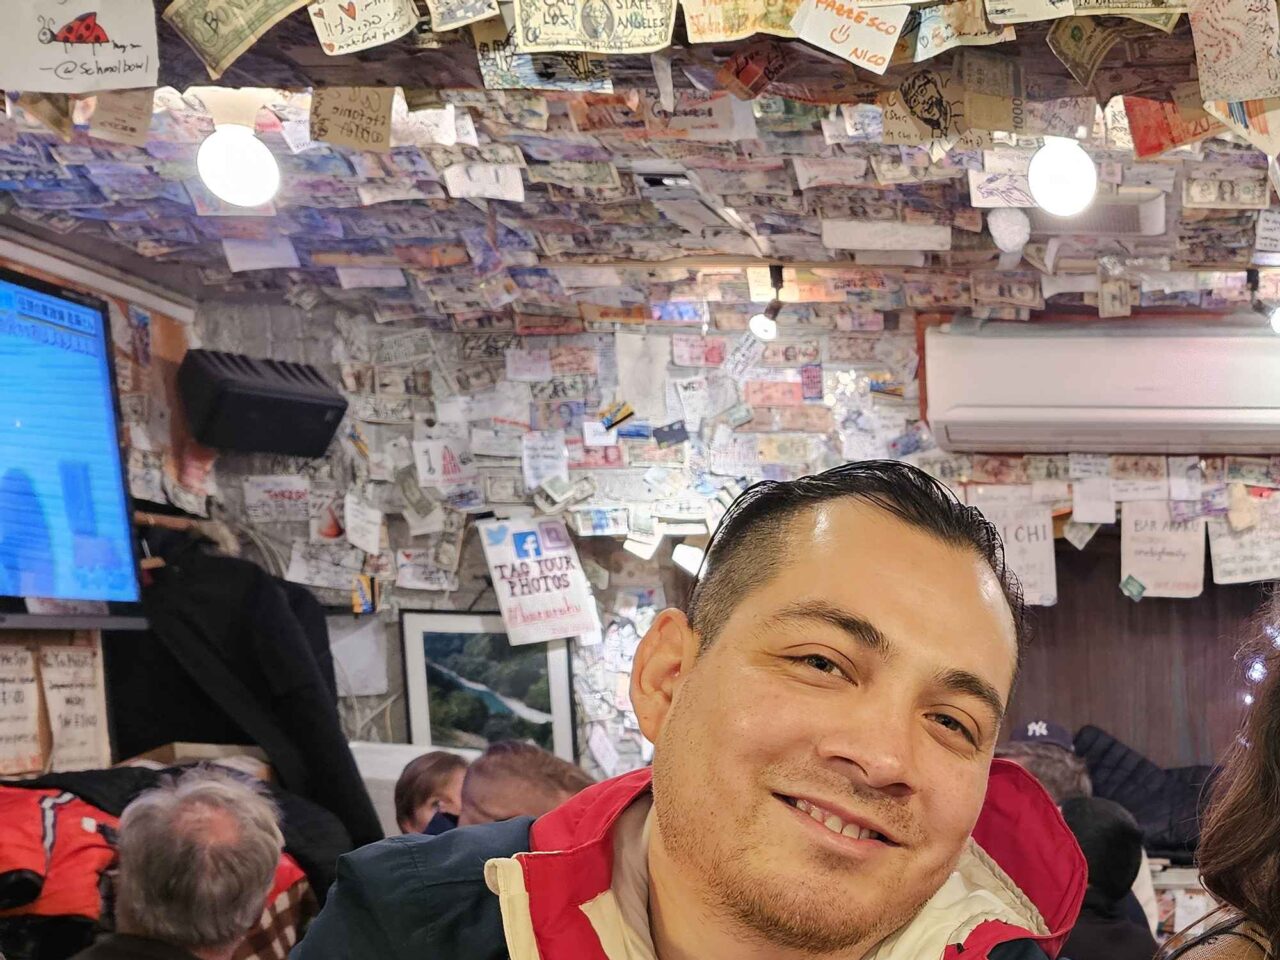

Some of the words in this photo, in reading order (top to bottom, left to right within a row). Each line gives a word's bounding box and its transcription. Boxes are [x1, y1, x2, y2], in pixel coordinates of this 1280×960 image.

[617, 15, 665, 29] ANGELES
[848, 46, 887, 67] NICO
[494, 561, 530, 580] TAG
[535, 555, 576, 576] YOUR
[507, 573, 571, 597] PHOTOS
